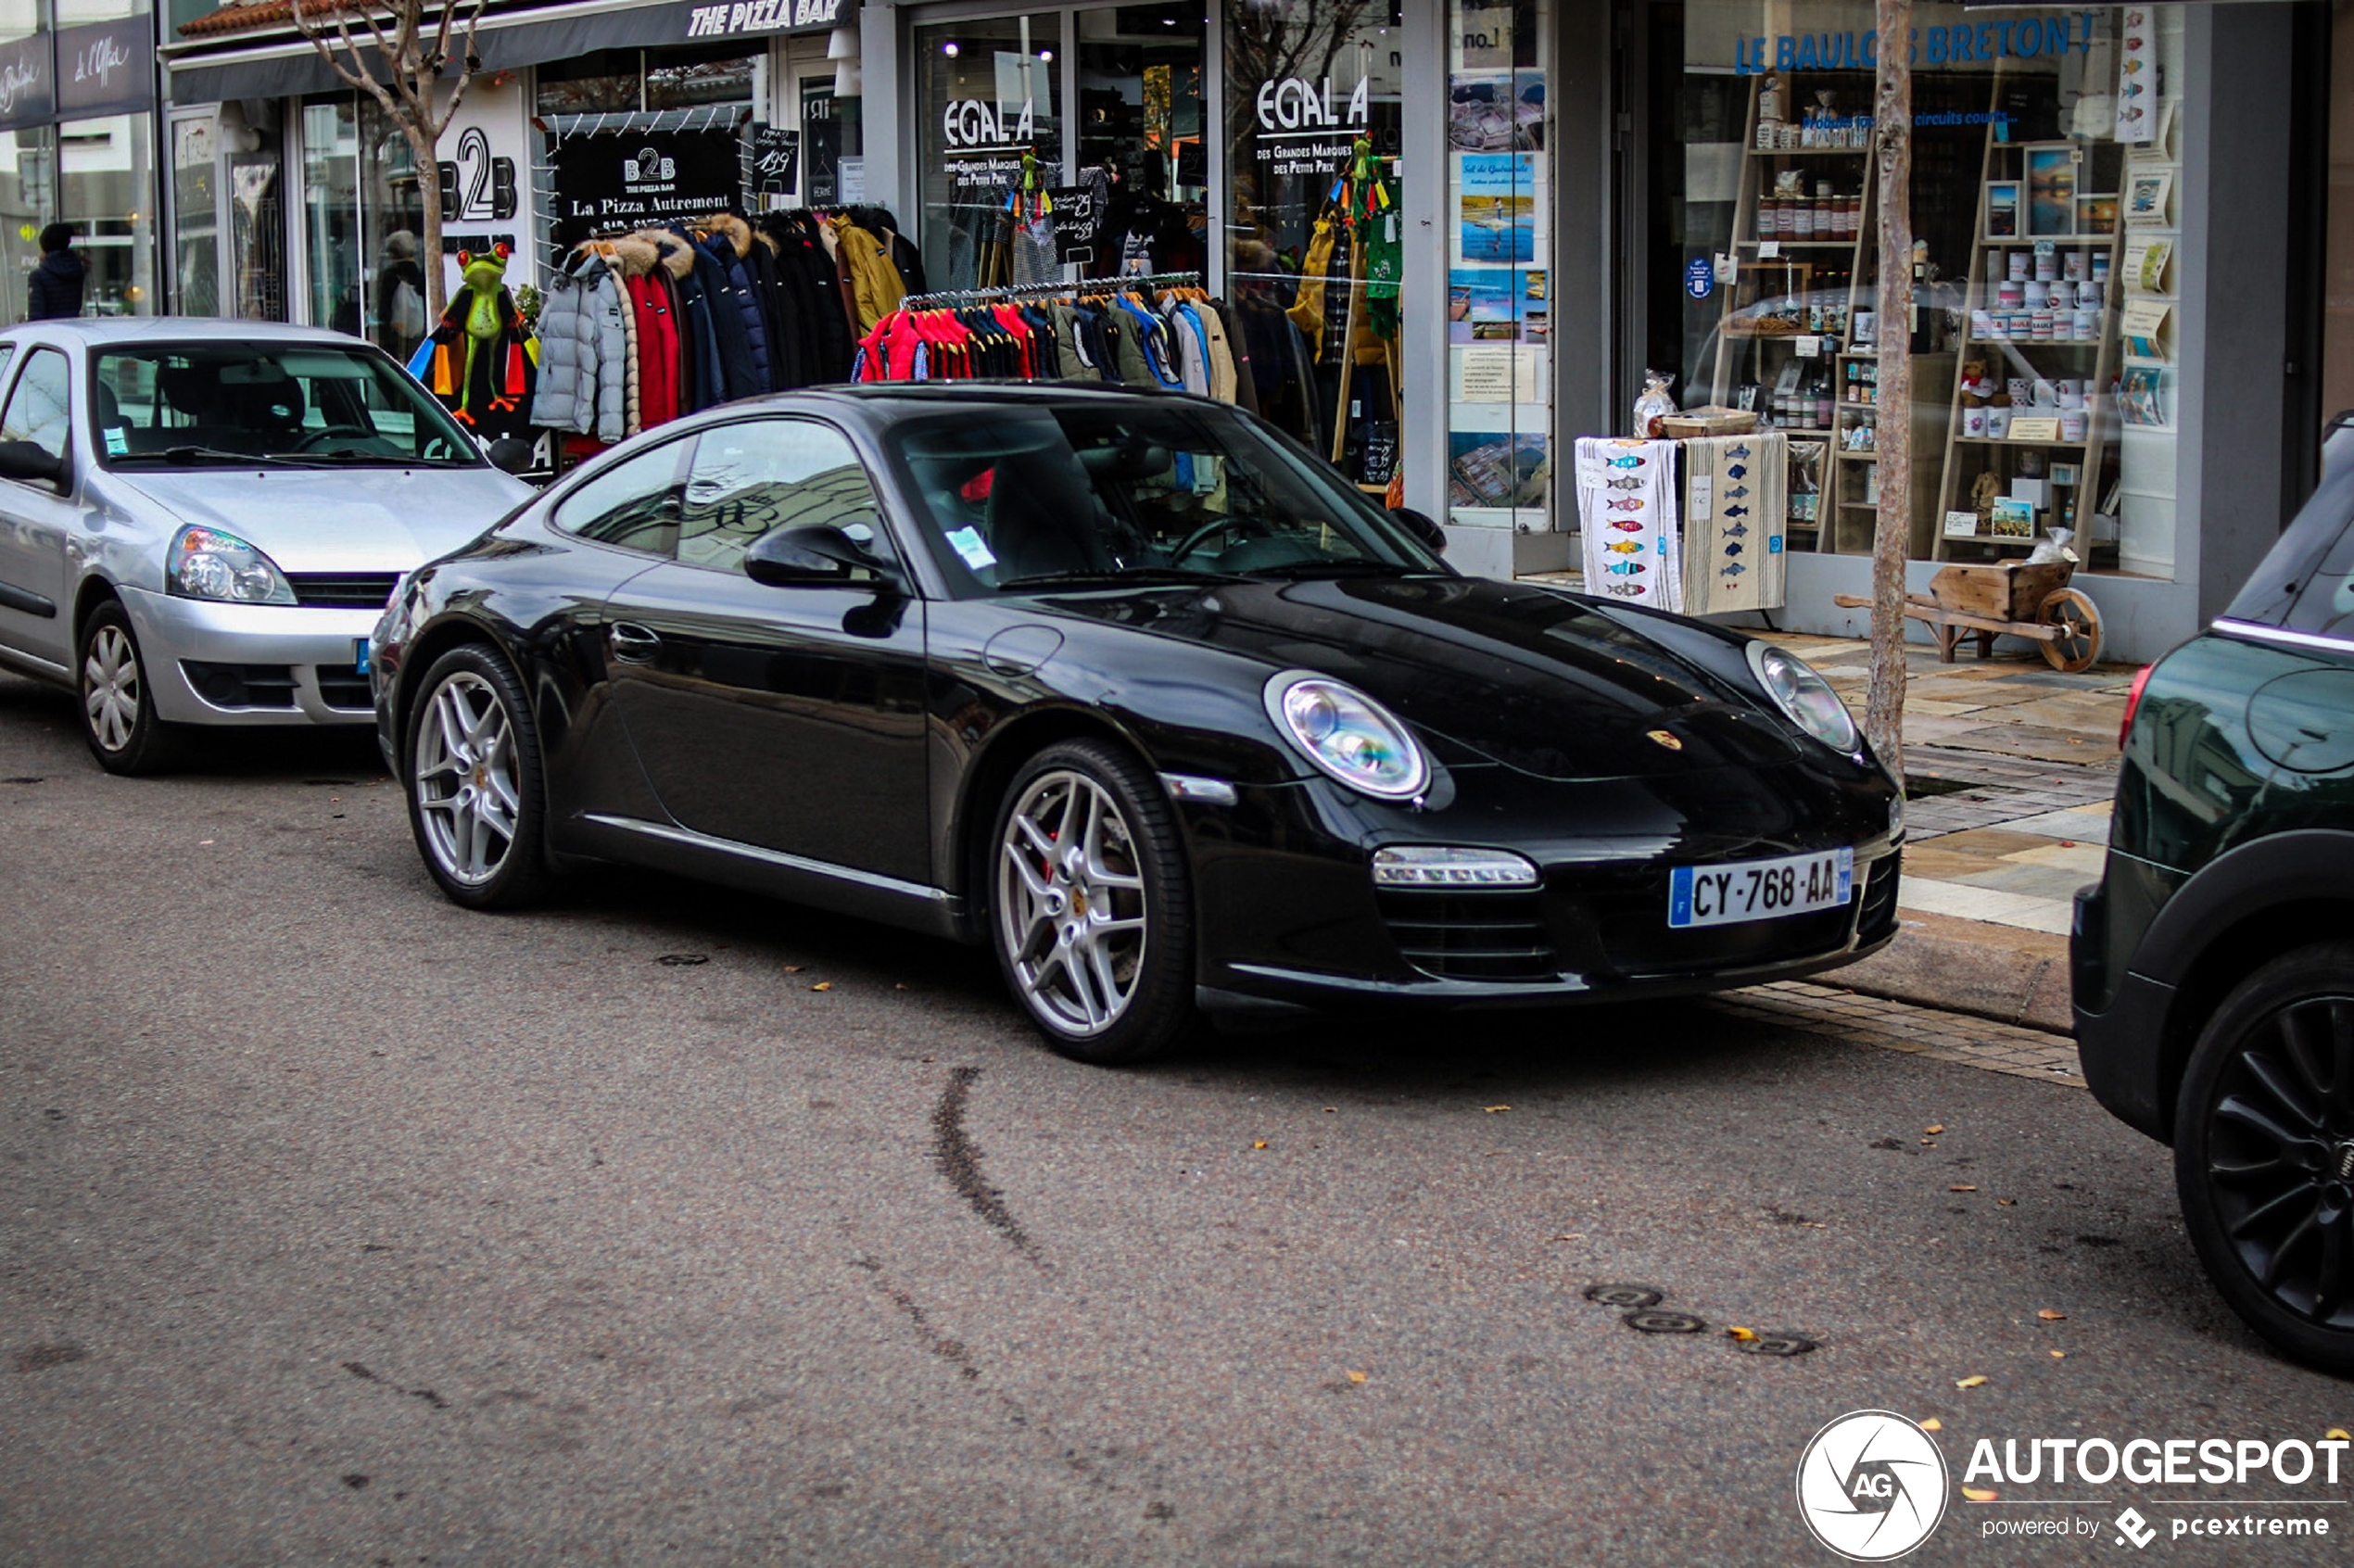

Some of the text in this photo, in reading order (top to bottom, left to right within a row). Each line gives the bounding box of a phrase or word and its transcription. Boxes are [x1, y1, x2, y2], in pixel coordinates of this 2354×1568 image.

[688, 0, 841, 37] THE PIZZA BAR
[1736, 36, 1766, 76] LE
[1777, 27, 1917, 73] BAULO
[1927, 17, 2070, 66] BRETON
[944, 96, 1033, 145] EGAL A
[1257, 74, 1368, 130] EGAL A
[1915, 110, 1962, 126] circuits
[437, 126, 518, 221] B2B
[624, 147, 676, 182] B2B
[572, 194, 730, 216] La Pizza Autrement
[626, 185, 639, 194] THE
[639, 184, 660, 193] PIZZA
[1693, 858, 1833, 917] CY-768-AA
[1677, 901, 1685, 914] F
